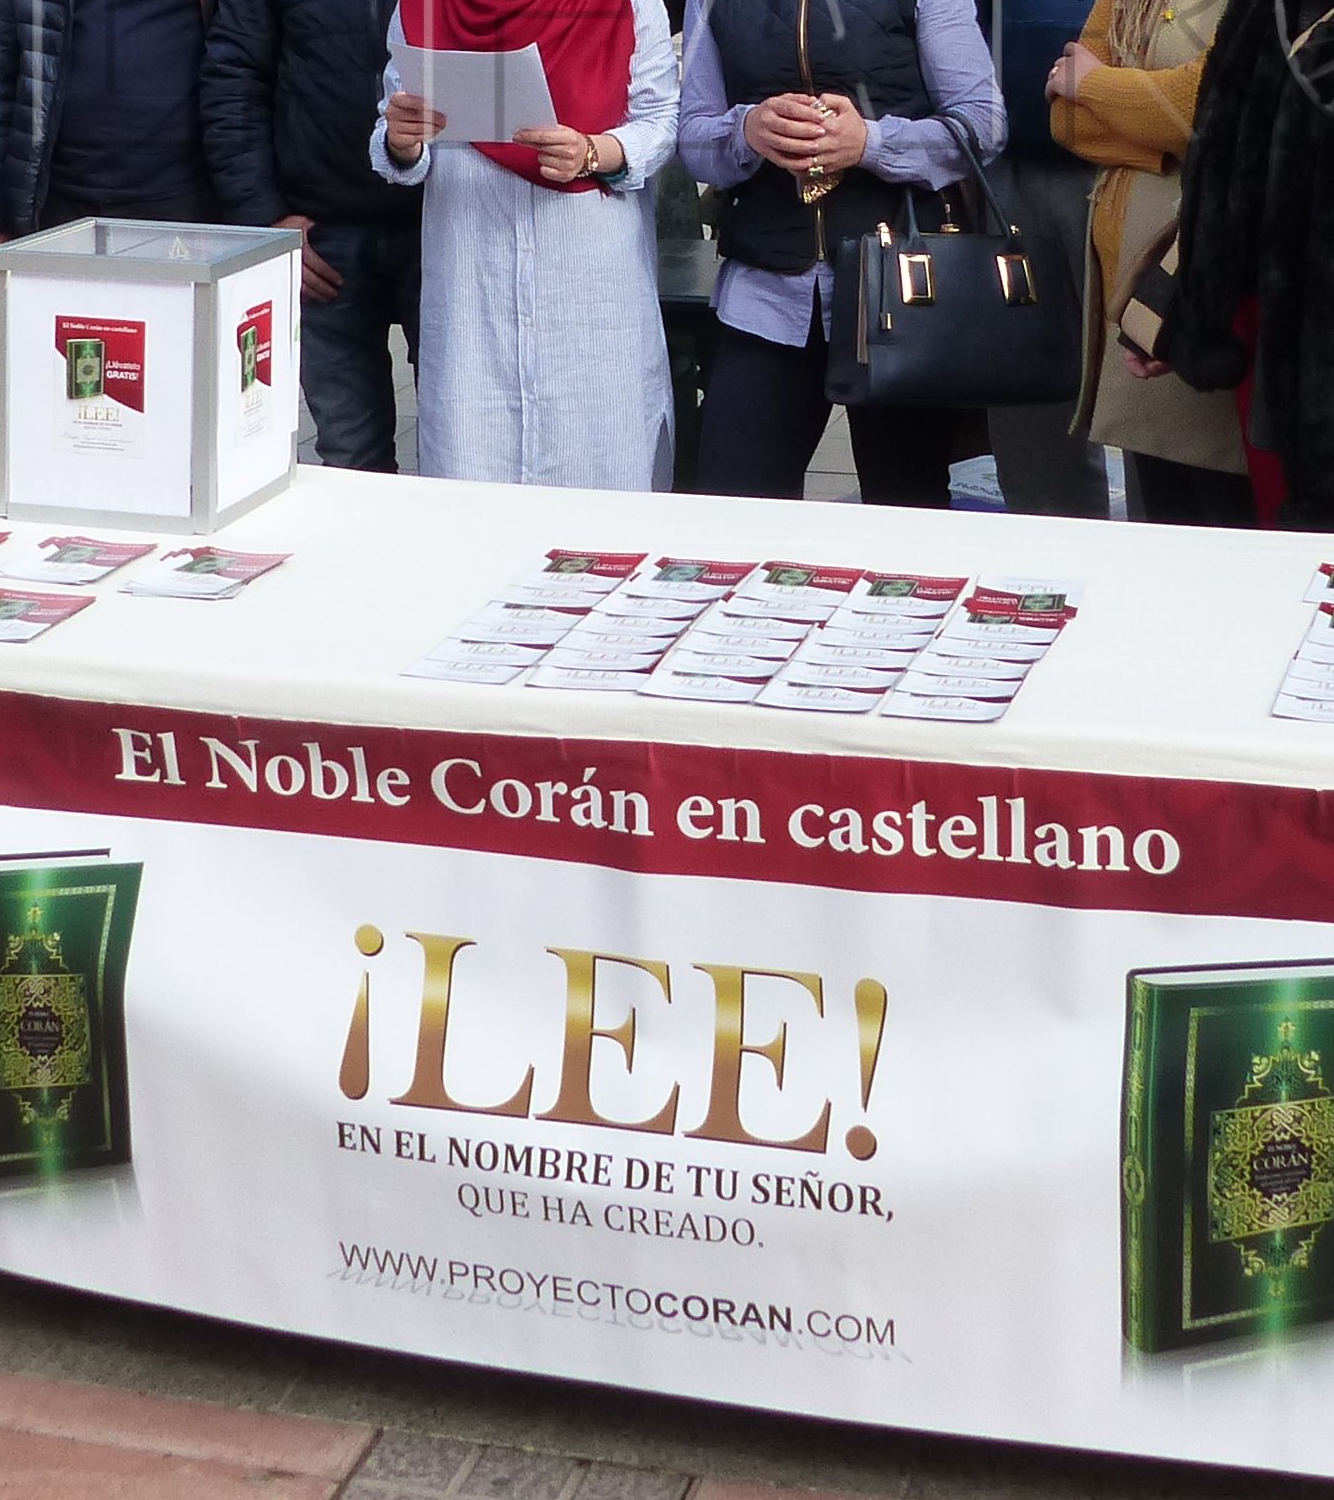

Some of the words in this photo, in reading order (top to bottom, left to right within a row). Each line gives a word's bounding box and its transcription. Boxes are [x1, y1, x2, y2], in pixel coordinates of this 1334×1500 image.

[115, 727, 169, 785] El
[205, 736, 412, 808] Noble
[432, 758, 654, 837] Corán
[676, 795, 765, 844] en
[788, 796, 1182, 876] castellano
[338, 924, 889, 1162] ¡LEE!
[336, 1121, 382, 1154] EN
[394, 1129, 436, 1163] EL
[447, 1137, 613, 1189] NOMBRE
[624, 1157, 675, 1194] DE
[686, 1165, 739, 1200] TU
[751, 1171, 894, 1222] SEÑOR,
[457, 1183, 530, 1218] QUE
[541, 1195, 593, 1227] HA
[604, 1204, 764, 1248] CREADO.
[338, 1241, 895, 1346] WWW.PROYECTOCORAN.COM
